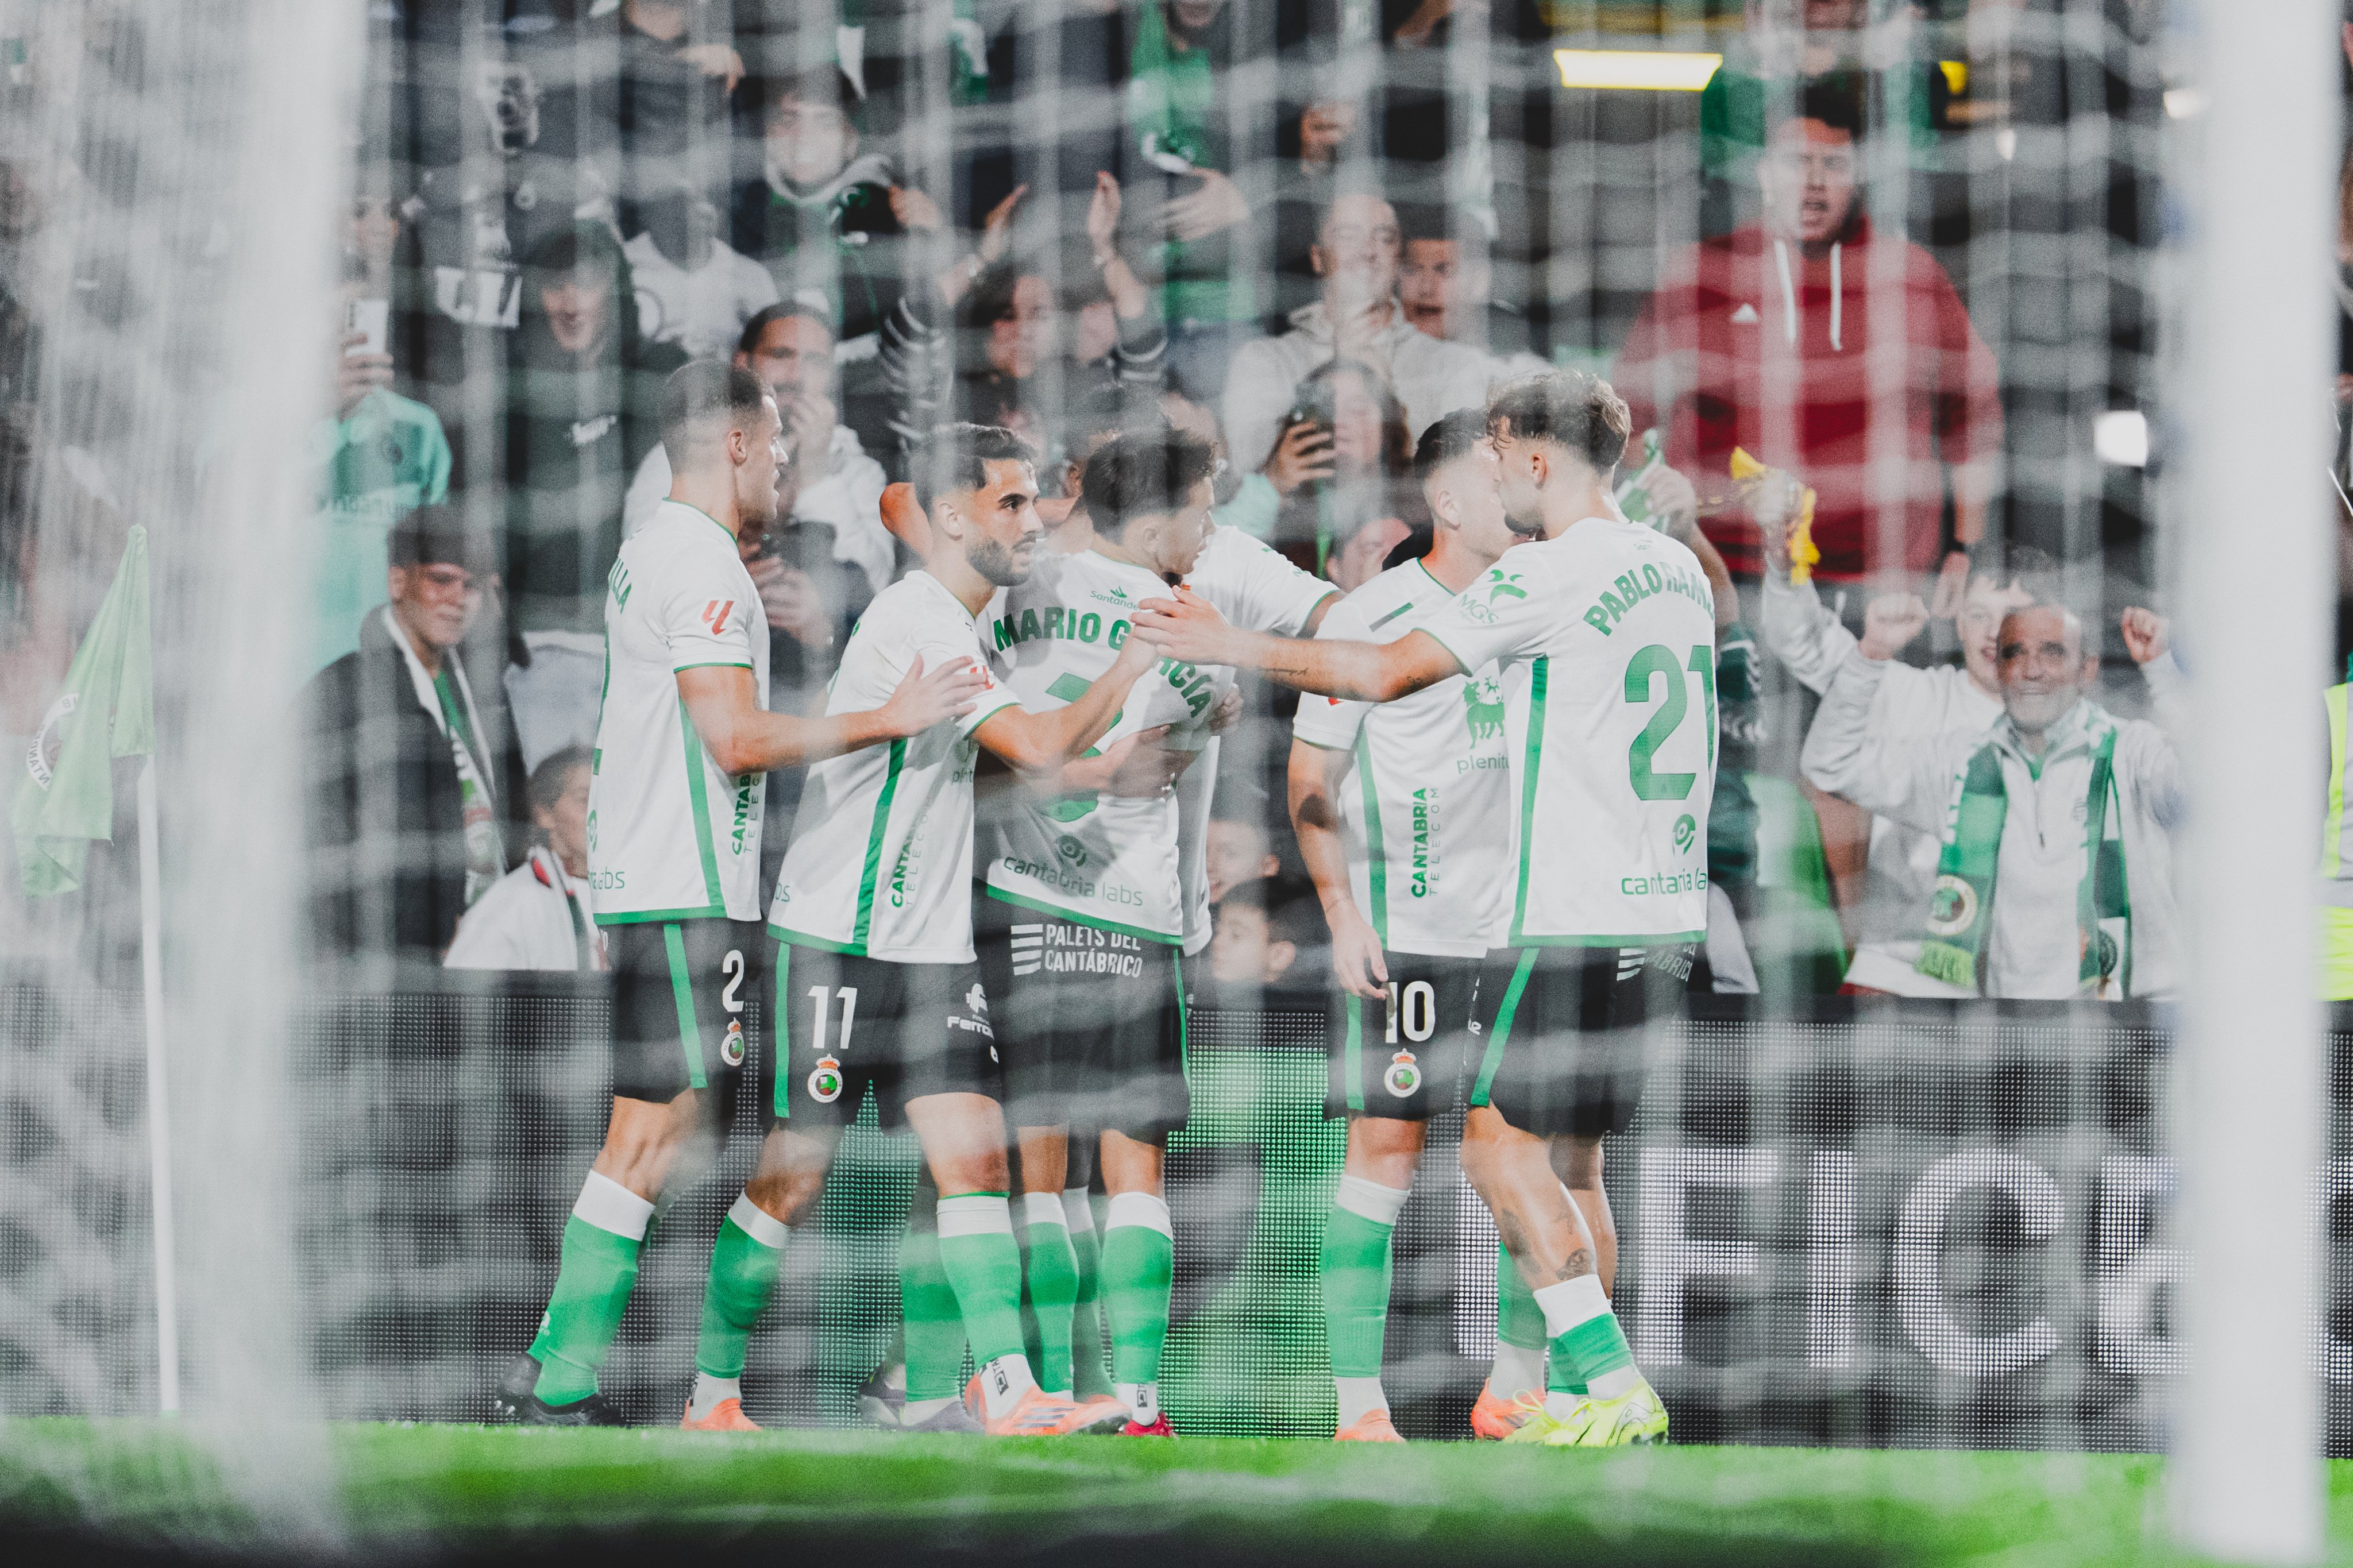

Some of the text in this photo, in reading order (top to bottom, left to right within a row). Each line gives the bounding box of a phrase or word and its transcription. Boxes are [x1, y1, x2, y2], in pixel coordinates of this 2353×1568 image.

[993, 607, 1101, 652] MARIO
[1090, 590, 1140, 611] Santande
[1457, 593, 1499, 623] MGS
[1583, 563, 1663, 636] PABLO
[1625, 644, 1715, 800] 21
[732, 774, 751, 855] CANTAB
[743, 777, 759, 853] TELEC
[1411, 787, 1429, 898] CANTABRIA
[1429, 788, 1441, 897] TELECOM
[906, 809, 930, 906] TELECO
[1621, 867, 1707, 895] cantaria la
[1102, 881, 1143, 906] labs
[1044, 948, 1143, 978] CANTÁBRICO
[1046, 924, 1141, 951] PALETS DEL
[723, 949, 745, 1012] 2
[1381, 980, 1436, 1043] 10
[808, 985, 858, 1049] 11
